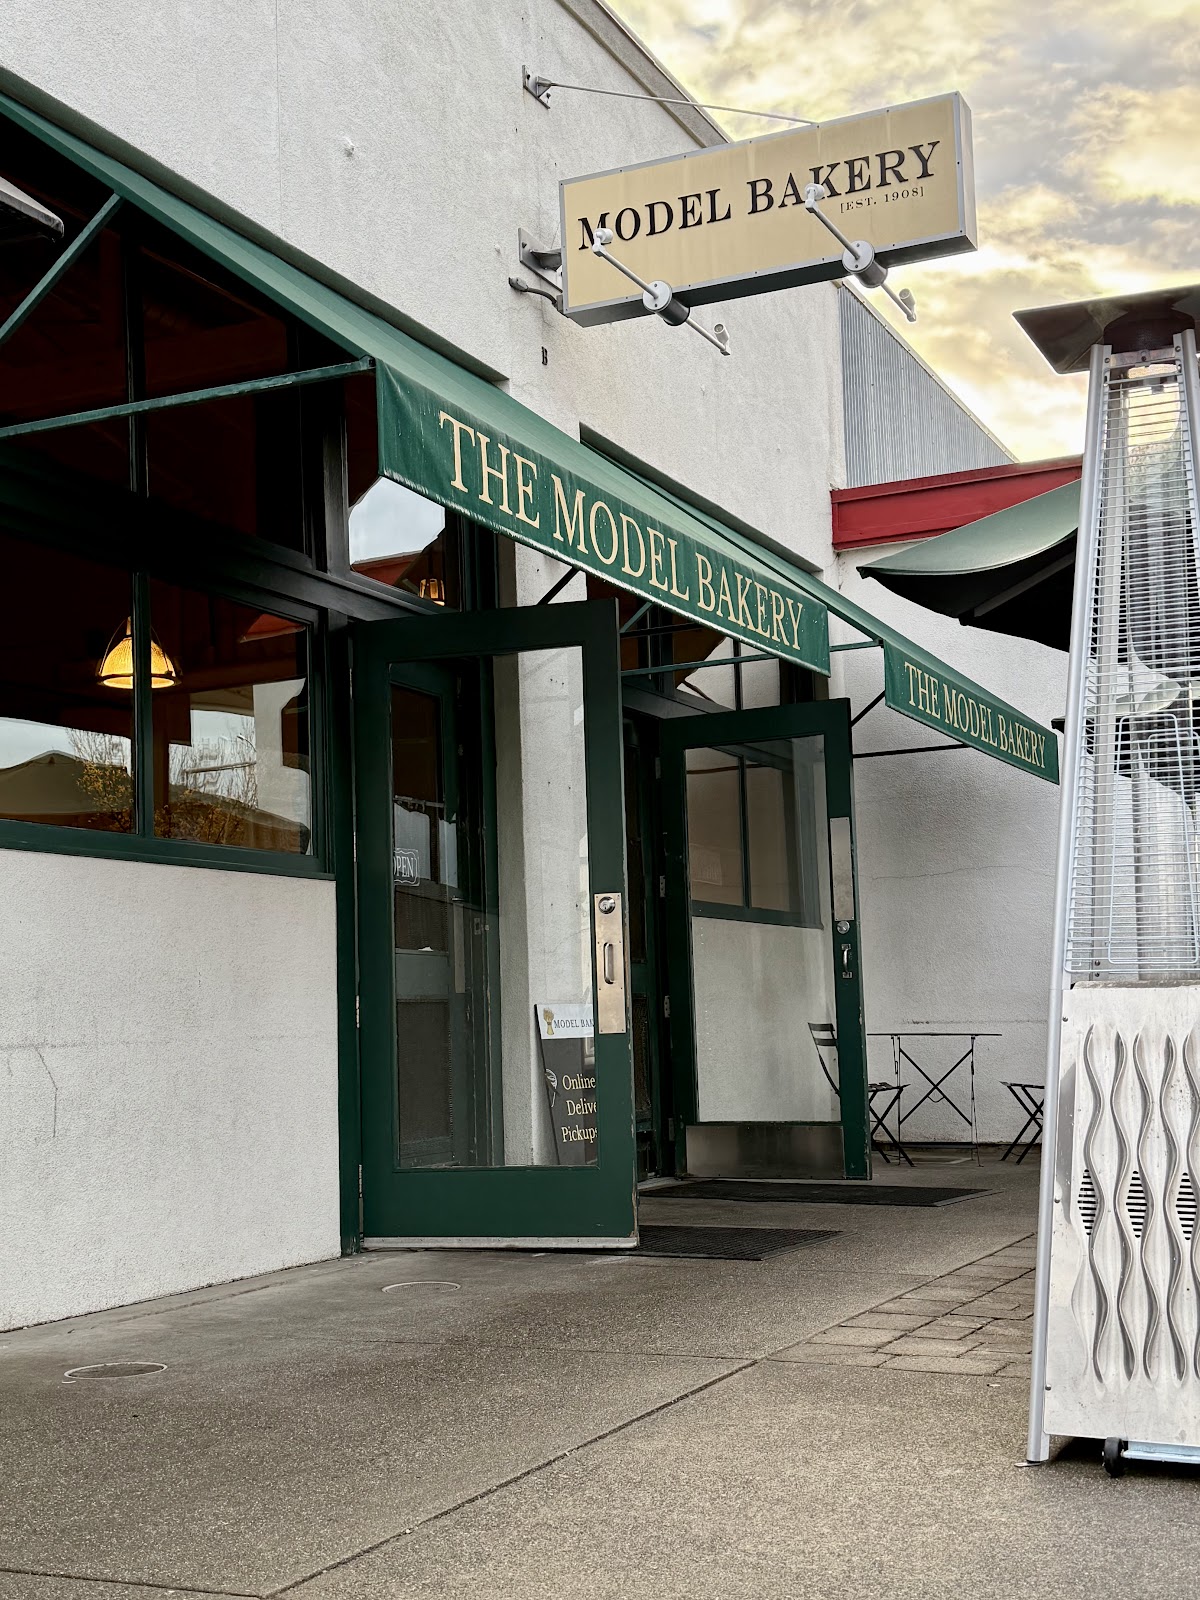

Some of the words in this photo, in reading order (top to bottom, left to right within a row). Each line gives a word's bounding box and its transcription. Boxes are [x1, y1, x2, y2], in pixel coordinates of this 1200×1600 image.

[578, 188, 732, 251] MODEL
[746, 140, 941, 216] BAKERY
[840, 196, 877, 213] [EST.
[884, 186, 924, 203] 1908]
[439, 411, 541, 529] THE
[550, 473, 690, 600] MODEL
[696, 552, 803, 650] BAKERY
[905, 661, 941, 719] THE
[943, 683, 998, 747] MODEL
[998, 714, 1046, 768] BAKERY
[553, 1019, 580, 1028] MODEL
[562, 1073, 596, 1090] Online
